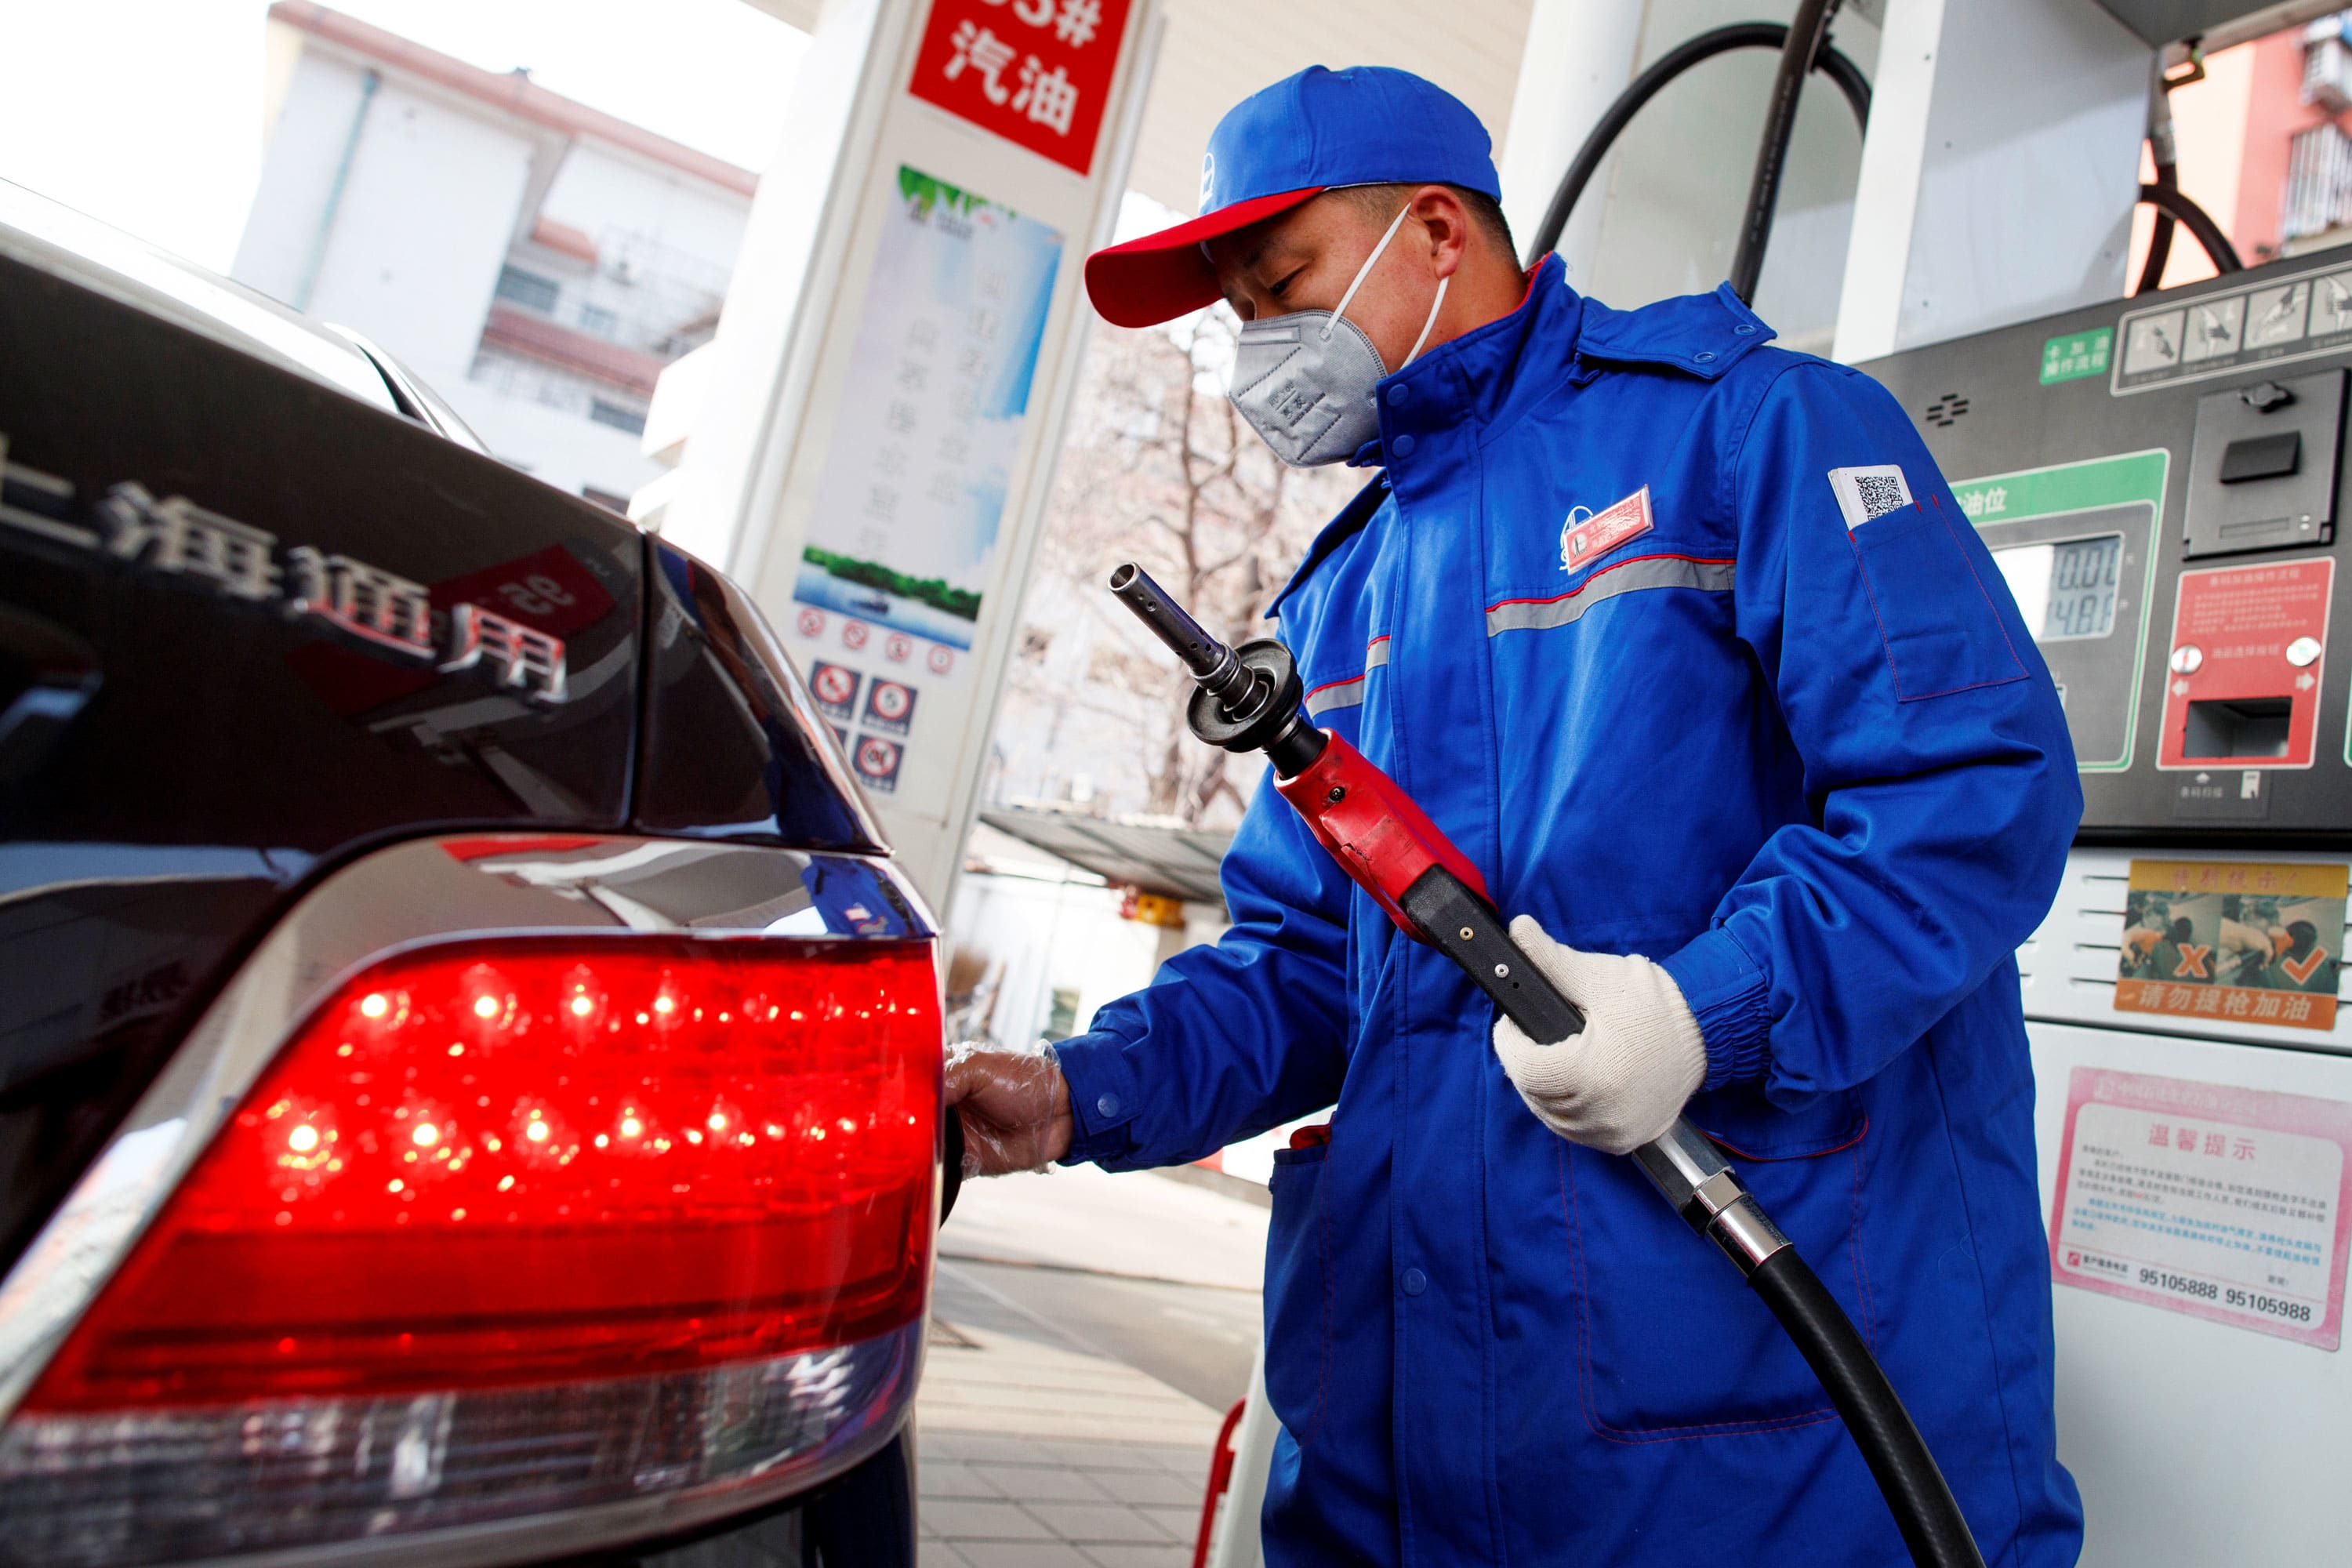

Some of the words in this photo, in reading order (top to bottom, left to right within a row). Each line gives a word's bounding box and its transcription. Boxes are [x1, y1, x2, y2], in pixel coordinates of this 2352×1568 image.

[943, 18, 1080, 136] 汽油
[2138, 983, 2312, 1022] 请勿提枪加油
[2148, 1123, 2257, 1162] 温馨提示
[2139, 1268, 2219, 1300] 95105888
[2225, 1288, 2312, 1323] 95105988
